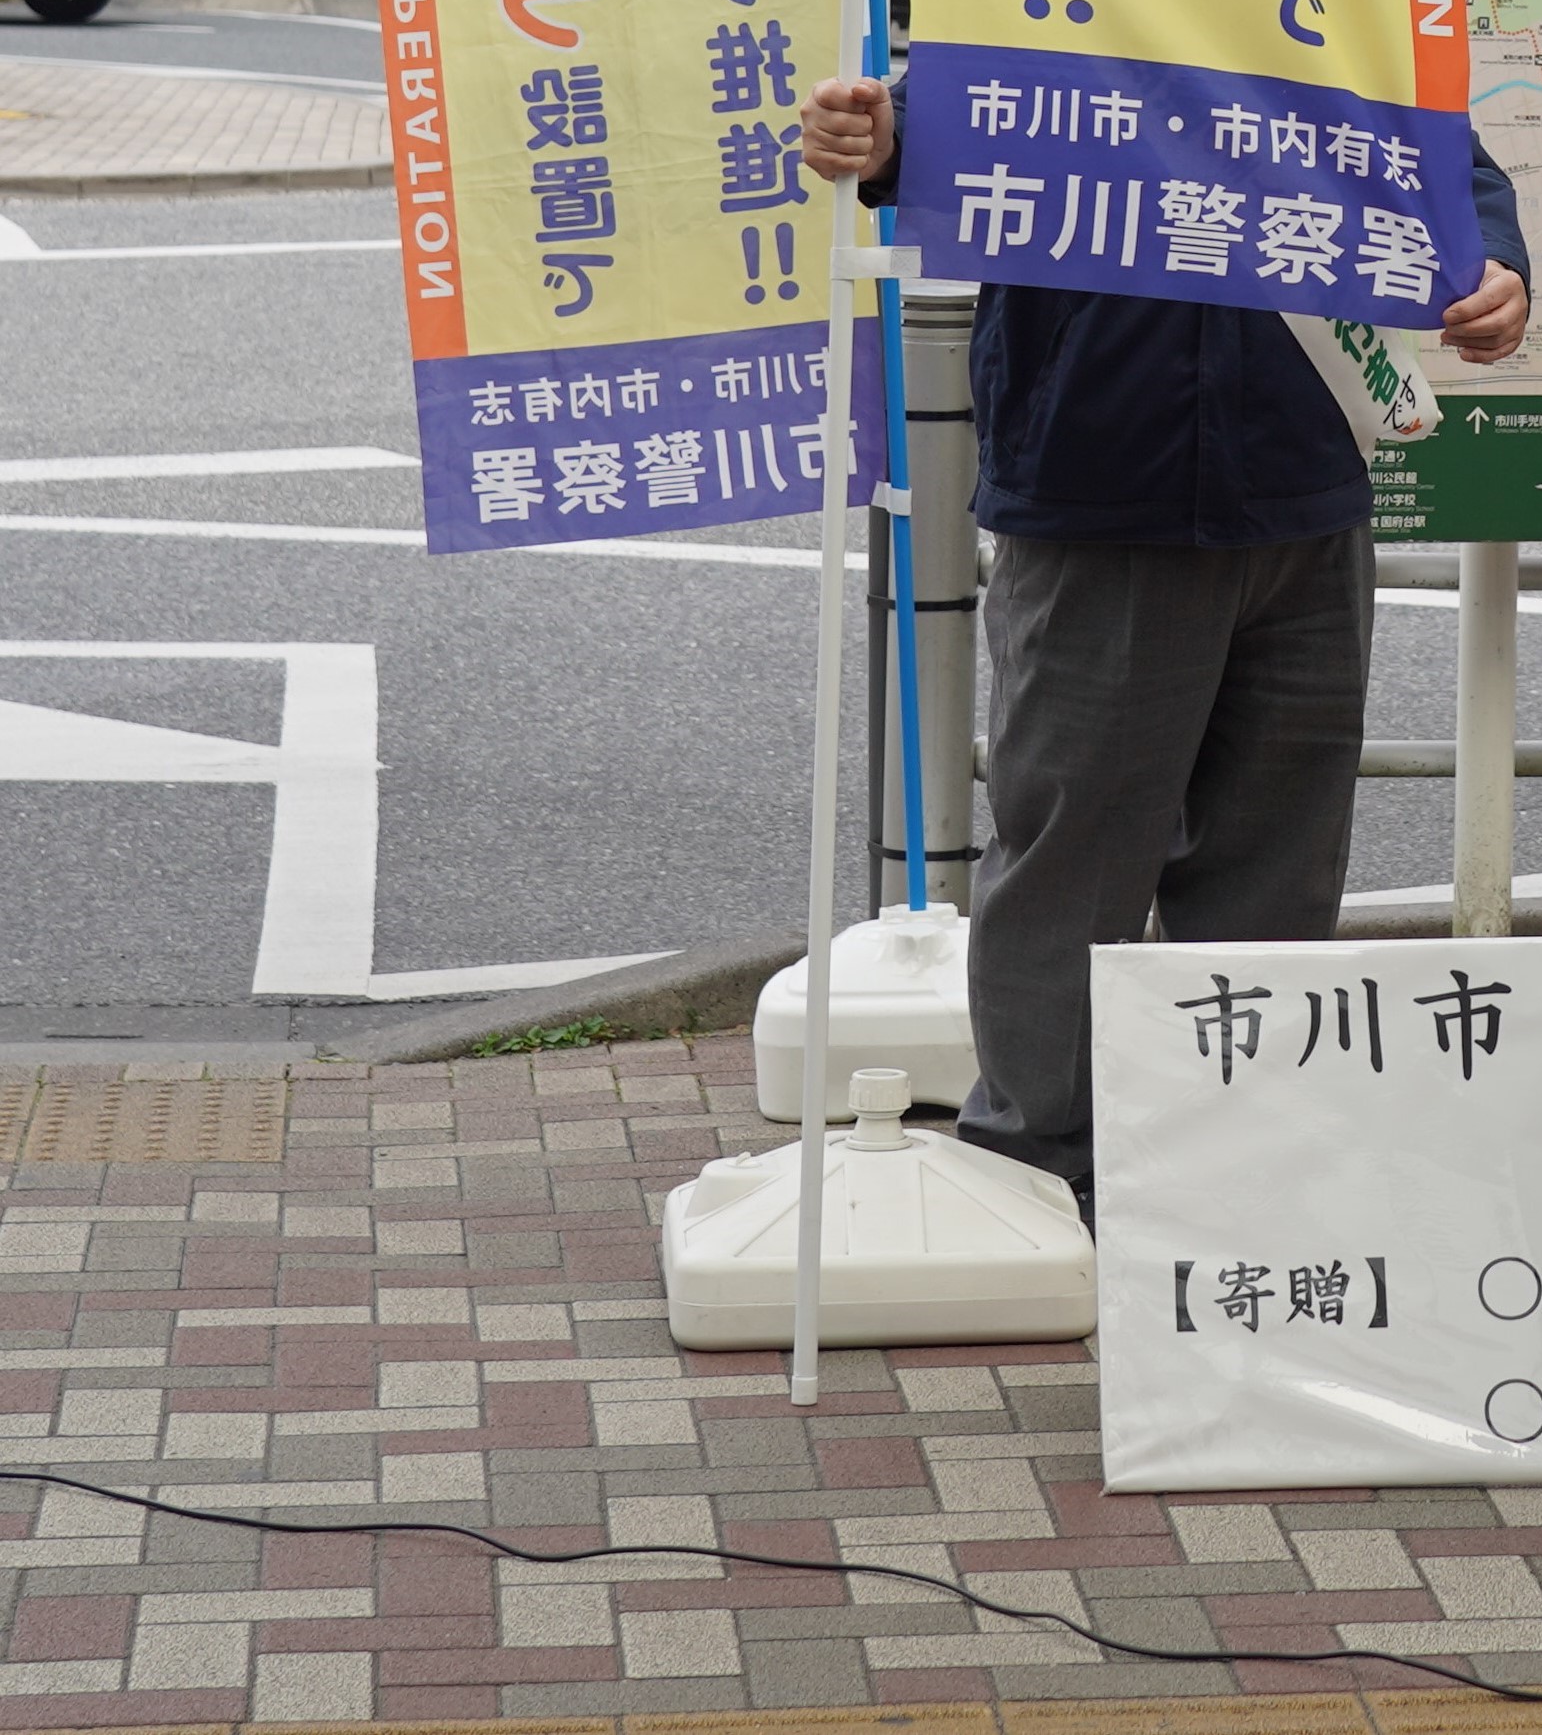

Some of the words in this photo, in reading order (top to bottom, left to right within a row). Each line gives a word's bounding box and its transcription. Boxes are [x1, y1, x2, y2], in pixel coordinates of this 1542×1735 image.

[966, 79, 1423, 193] 市川市・市内有志
[954, 163, 1442, 306] 市川警察署
[1174, 969, 1512, 1085] 市川市
